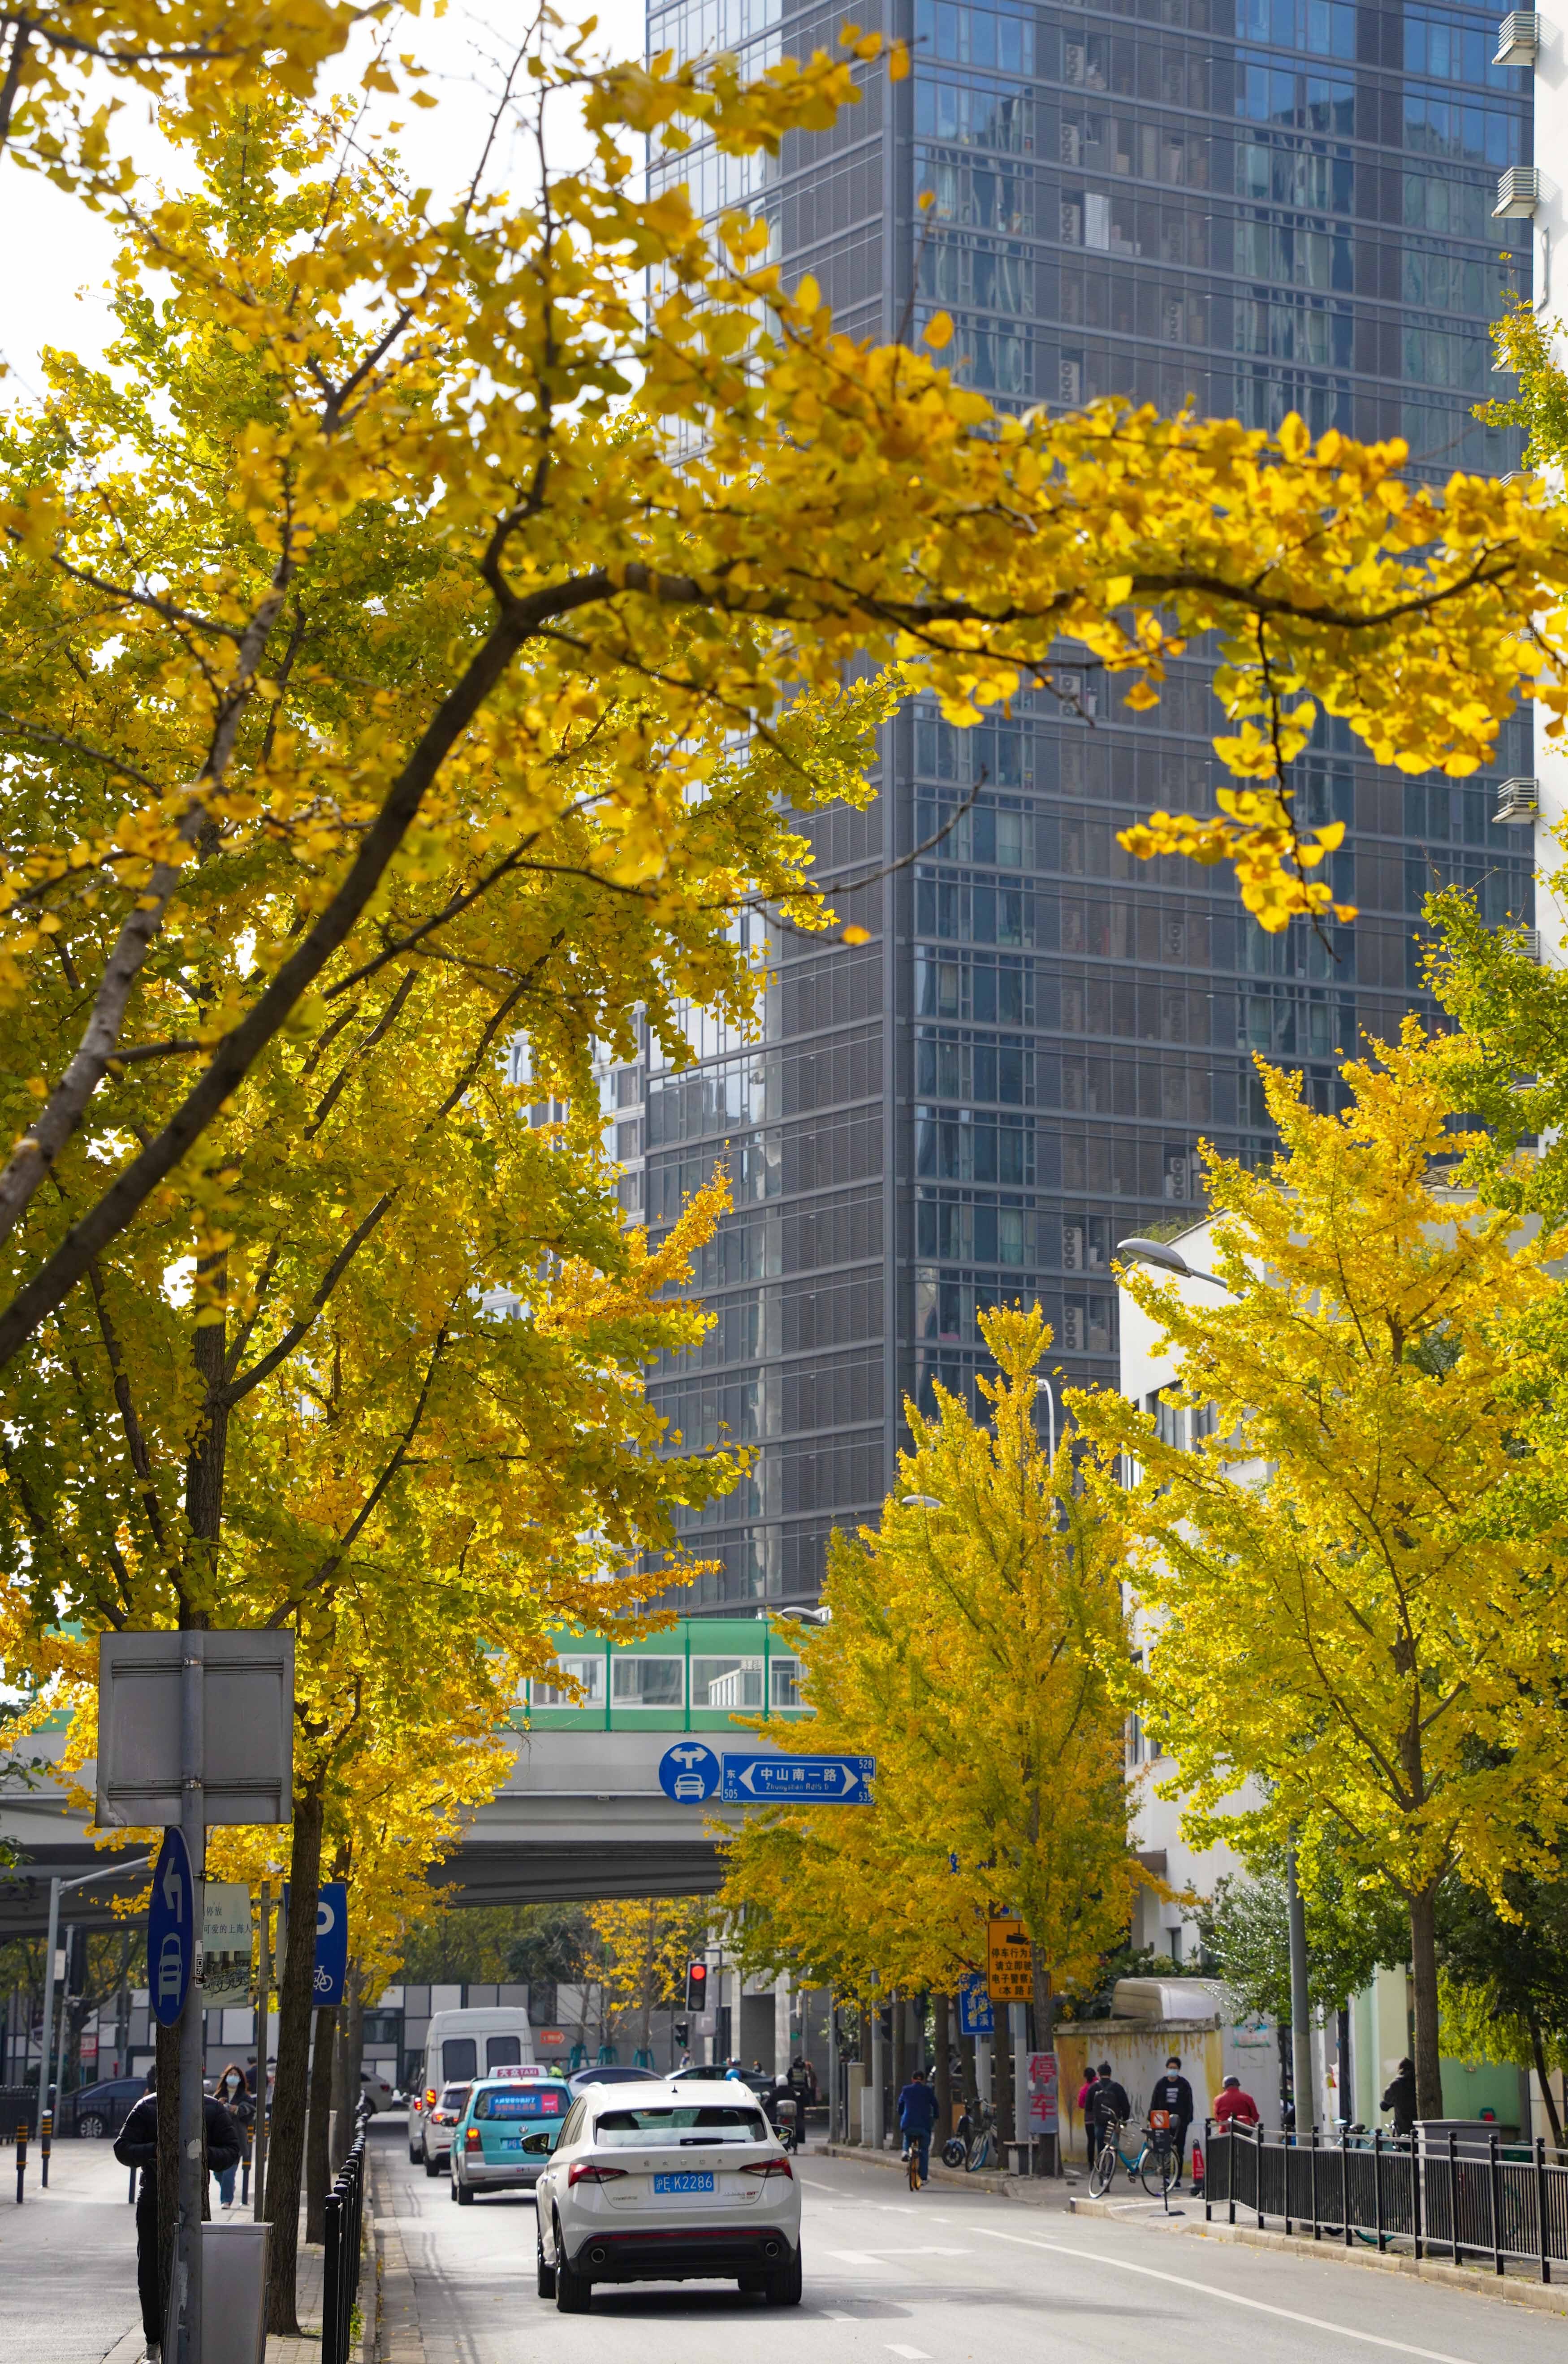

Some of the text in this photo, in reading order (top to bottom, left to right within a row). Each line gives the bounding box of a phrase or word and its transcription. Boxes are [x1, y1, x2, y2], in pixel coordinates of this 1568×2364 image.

[859, 1759, 873, 1769] 528
[726, 1770, 736, 1779] 东
[760, 1768, 837, 1782] 中山南一路
[724, 1789, 738, 1799] 505
[203, 1906, 223, 1916] 停放
[203, 1923, 251, 1934] 可爱的上海人
[1028, 2055, 1056, 2121] 停车
